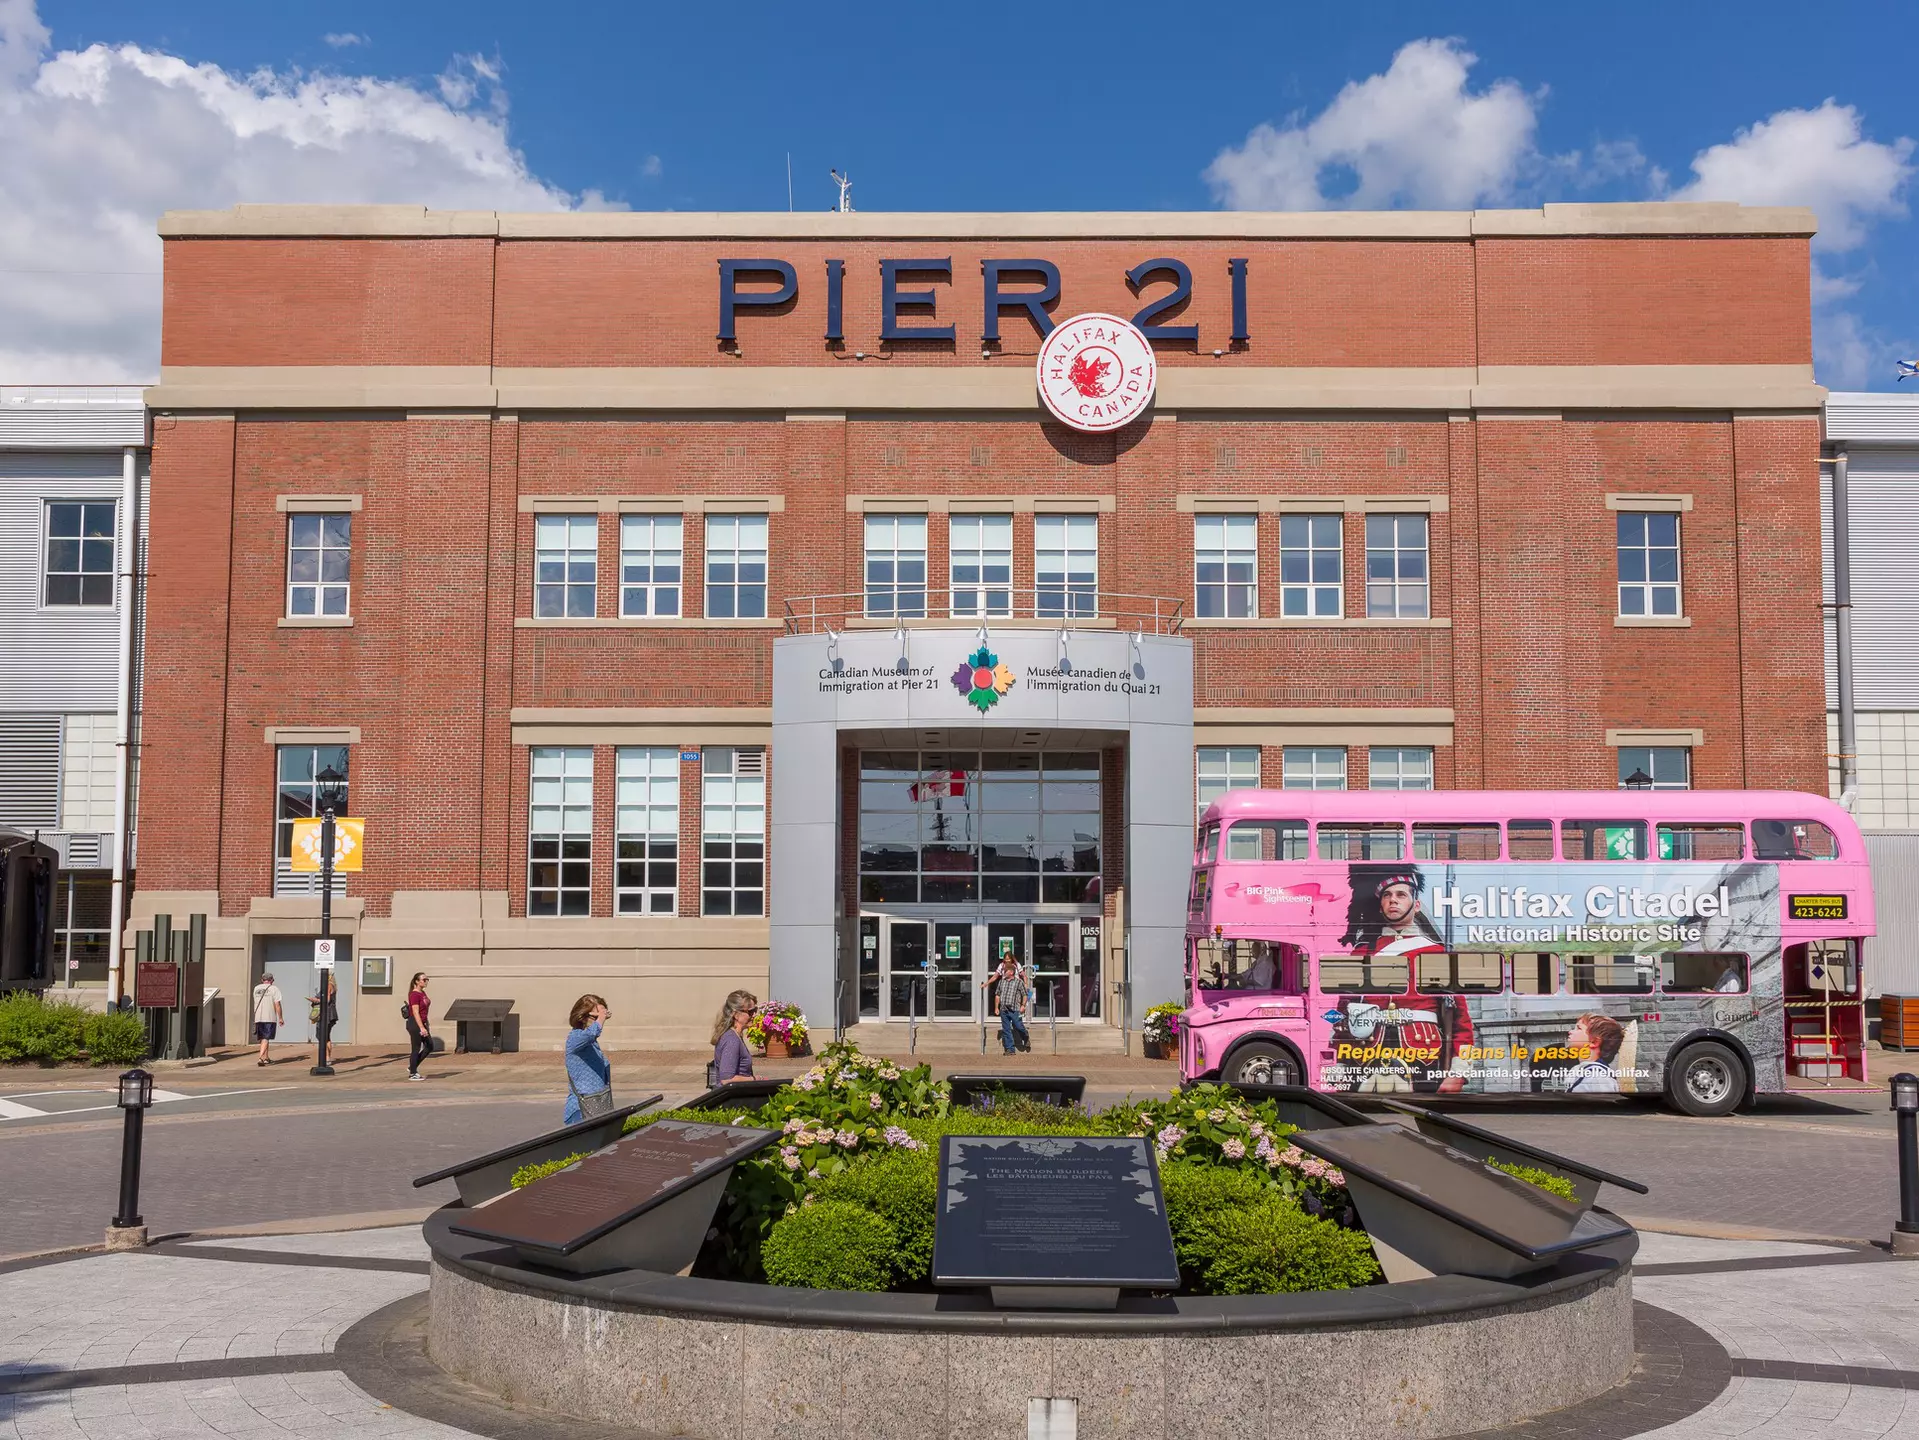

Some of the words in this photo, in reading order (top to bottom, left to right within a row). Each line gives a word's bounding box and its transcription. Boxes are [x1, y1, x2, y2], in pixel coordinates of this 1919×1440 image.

[716, 256, 1061, 342] PIER
[1050, 328, 1121, 380] HALIFAX
[1078, 366, 1142, 418] CANADA
[819, 667, 868, 679] Canadian
[872, 667, 919, 677] Museum
[922, 666, 934, 676] of
[1026, 666, 1064, 677] Musée
[1068, 668, 1116, 679] canadien
[1119, 670, 1131, 680] de
[819, 680, 884, 694] Immigration
[887, 682, 898, 690] at
[902, 680, 923, 690] Pier
[926, 679, 938, 689] 21
[1027, 678, 1100, 693] l'immigration
[1104, 682, 1118, 692] du
[1121, 682, 1146, 695] Quai
[1149, 684, 1160, 694] 21
[1264, 886, 1284, 894] Pink
[1263, 895, 1313, 904] Sightseeing
[1432, 885, 1574, 918] Halifax
[1586, 885, 1730, 919] Citadel
[1795, 908, 1843, 917] 423-6242
[1081, 927, 1100, 936] 1055
[1468, 924, 1558, 942] National
[1566, 924, 1651, 942] Historic
[1656, 924, 1701, 942] Site
[1350, 1008, 1413, 1018] IGHTSEEING
[1715, 1010, 1759, 1022] Canada
[1348, 1019, 1413, 1027] VERYWHERE
[1337, 1043, 1440, 1063] Replongez
[1458, 1044, 1505, 1060] dans
[1510, 1044, 1529, 1060] le
[1533, 1044, 1591, 1062] passé
[1320, 1075, 1355, 1083] HALIFAX,
[1427, 1067, 1650, 1080] parcscanada.gc.ca/citadellehalifax
